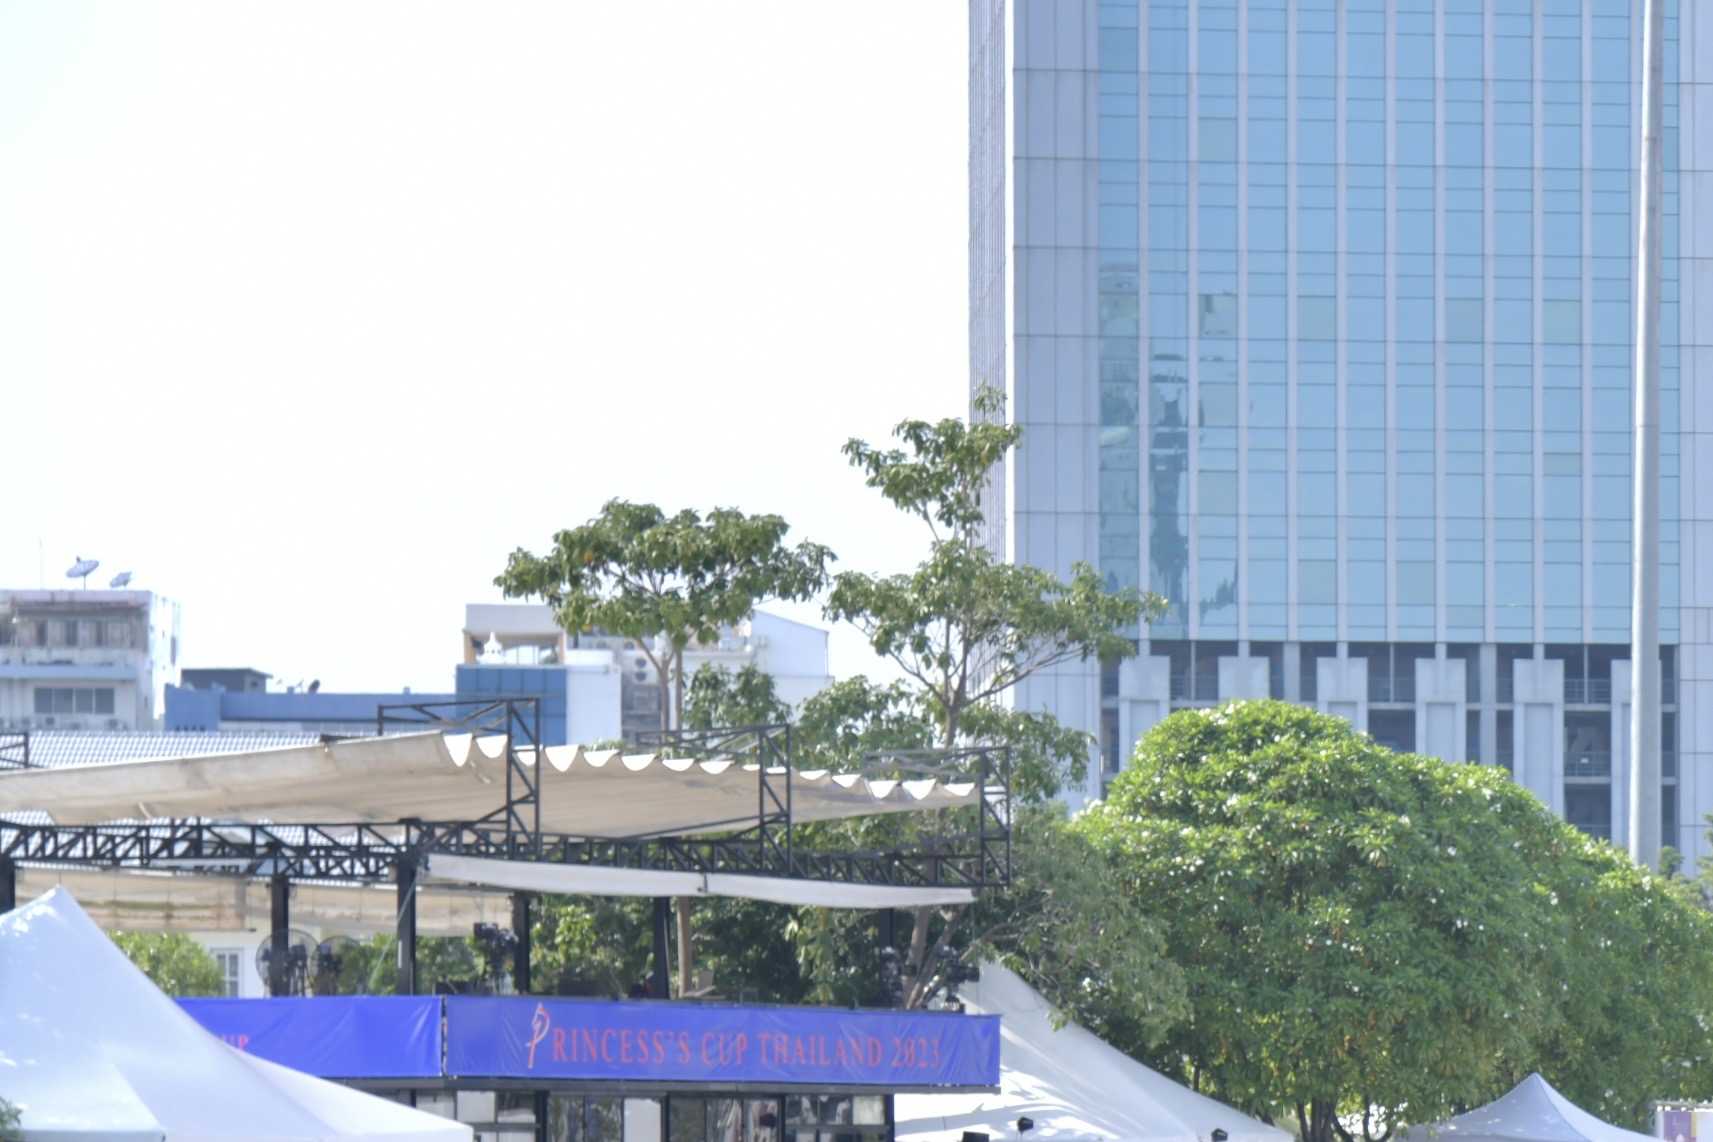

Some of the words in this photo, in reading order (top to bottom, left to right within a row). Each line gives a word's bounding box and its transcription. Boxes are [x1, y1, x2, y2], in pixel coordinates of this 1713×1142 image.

[526, 1002, 692, 1069] PRINCESS'S
[702, 1032, 748, 1066] CUP
[758, 1032, 883, 1068] THAILAND
[892, 1037, 941, 1068] 2023
